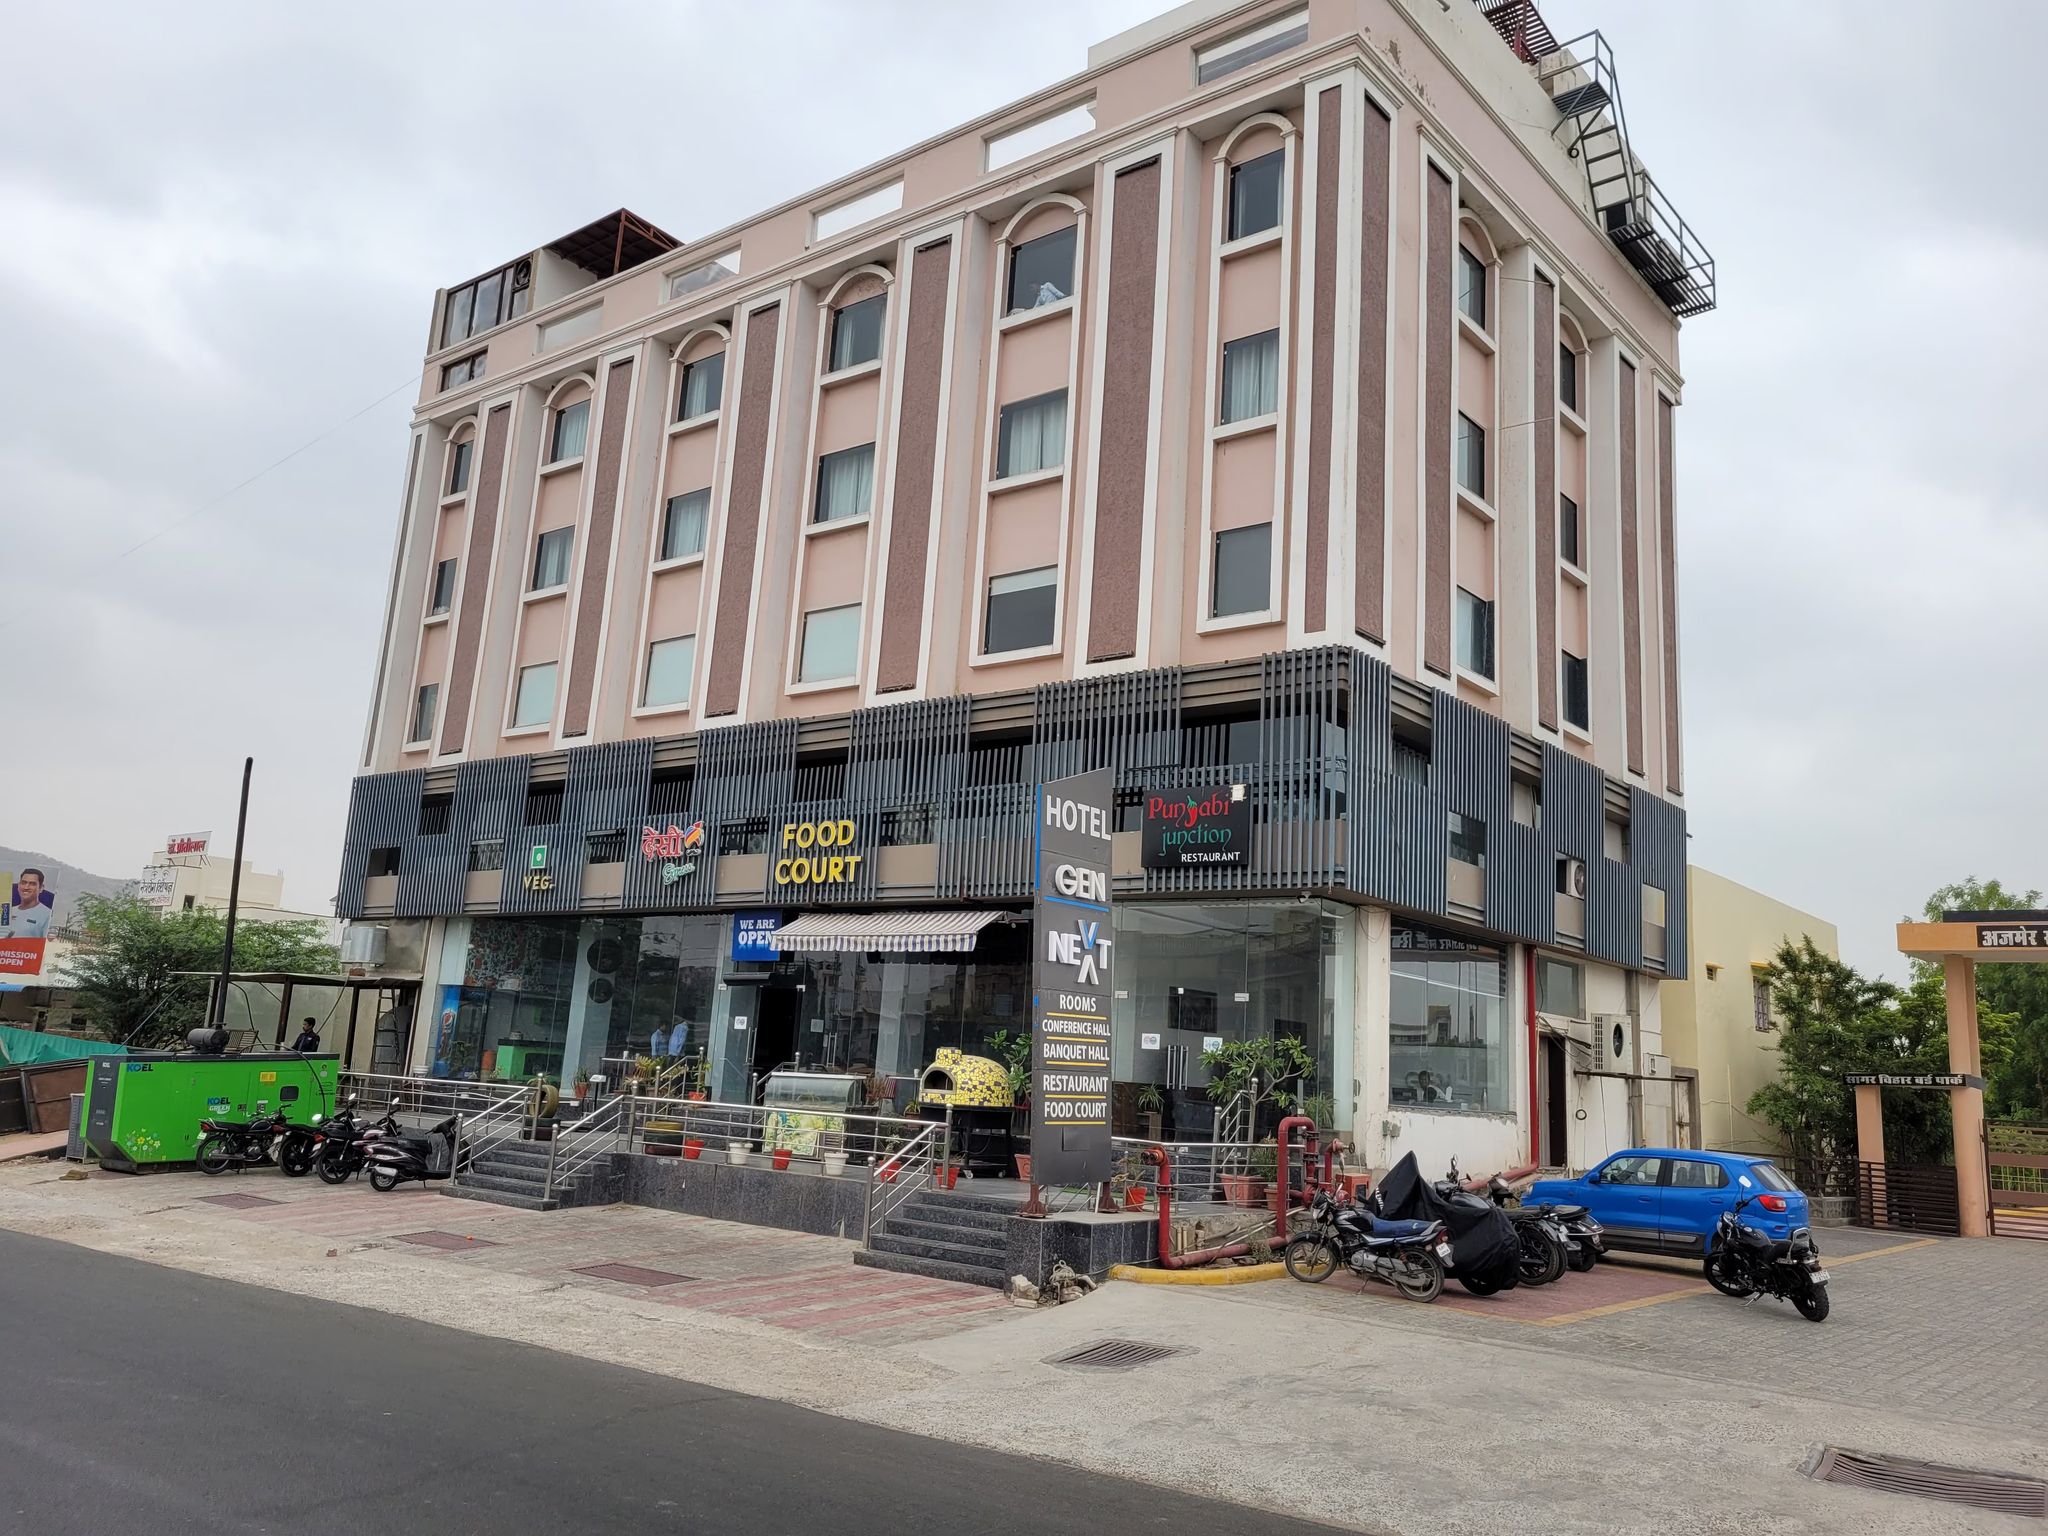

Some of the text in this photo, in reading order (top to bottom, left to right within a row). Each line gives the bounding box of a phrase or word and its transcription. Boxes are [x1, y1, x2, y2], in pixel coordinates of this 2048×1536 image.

[1047, 795, 1111, 840] HOTEL
[1148, 792, 1230, 828] Punjabi
[642, 825, 685, 861] देसी
[783, 820, 855, 849] FOOD
[1158, 824, 1231, 856] junction
[1181, 852, 1240, 862] RESTAURANT
[775, 856, 861, 884] COURT
[1055, 864, 1105, 902] GEN
[740, 919, 775, 930] WE ARE
[738, 931, 772, 945] OPEN
[1982, 926, 2037, 946] अजमेर
[0, 950, 37, 960] MISSION
[1048, 919, 1111, 985] NEXT
[0, 957, 23, 966] OPEN
[1060, 994, 1096, 1012] ROOMS
[1042, 1019, 1111, 1036] CONFERENCE HALL
[1043, 1043, 1110, 1061] BANQUET HALL
[127, 1063, 153, 1072] KOEL
[1043, 1074, 1108, 1092] RESTAURANT
[208, 1096, 230, 1104] KOEL
[1044, 1101, 1107, 1118] FOOD COURT
